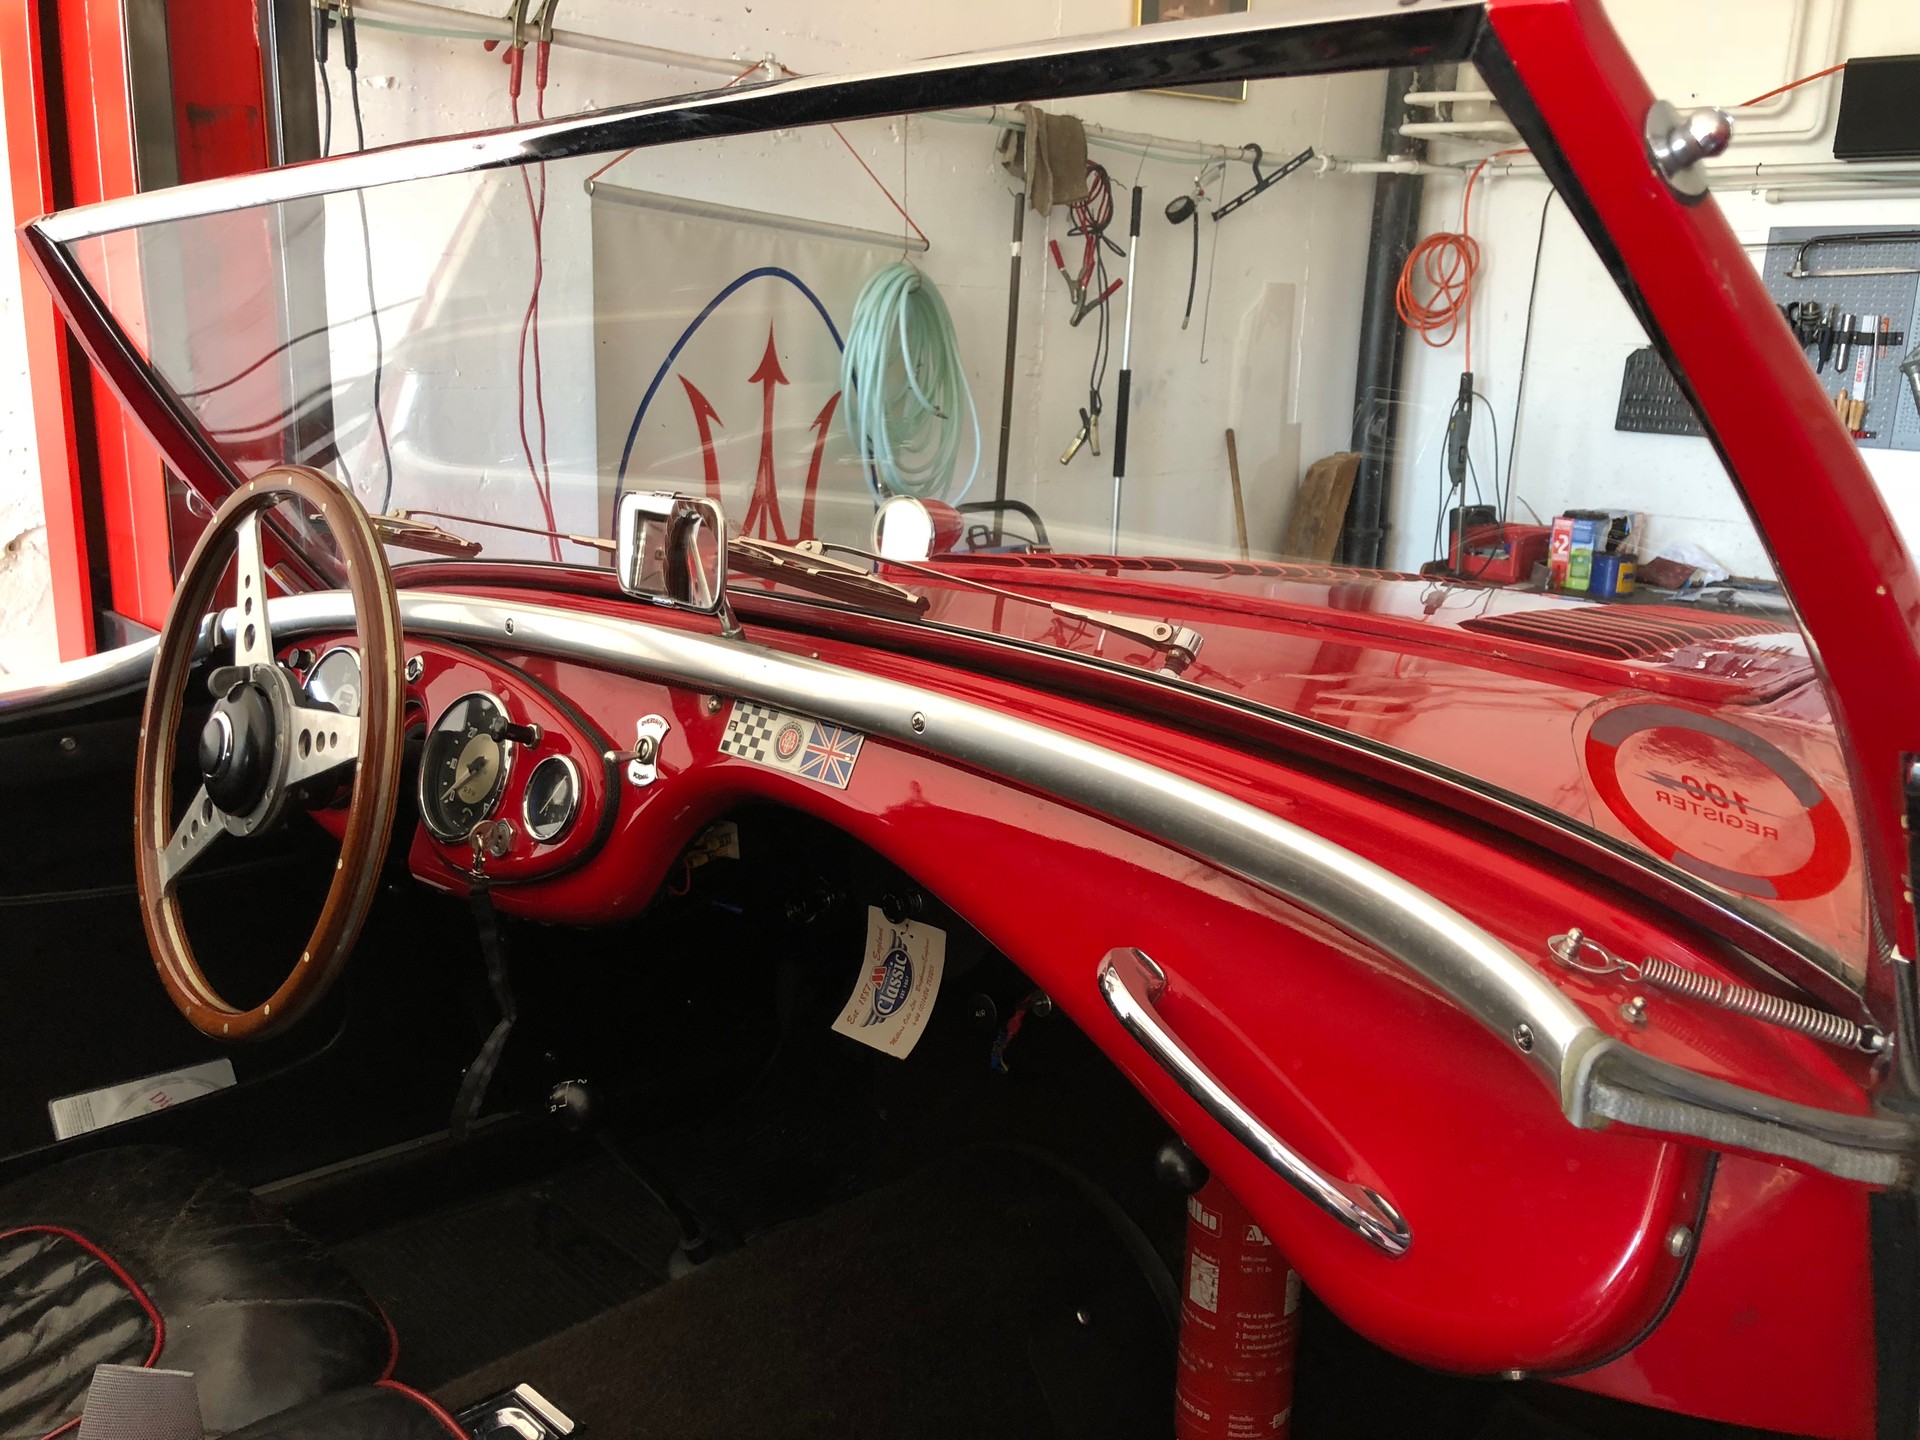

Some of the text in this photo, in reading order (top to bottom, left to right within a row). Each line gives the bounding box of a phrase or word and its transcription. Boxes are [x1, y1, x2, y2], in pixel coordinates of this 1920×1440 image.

[1856, 360, 1865, 382] DELTA
[872, 925, 884, 962] England
[859, 983, 872, 1005] 1887
[876, 953, 908, 1014] Classic
[149, 1091, 174, 1108] Di
